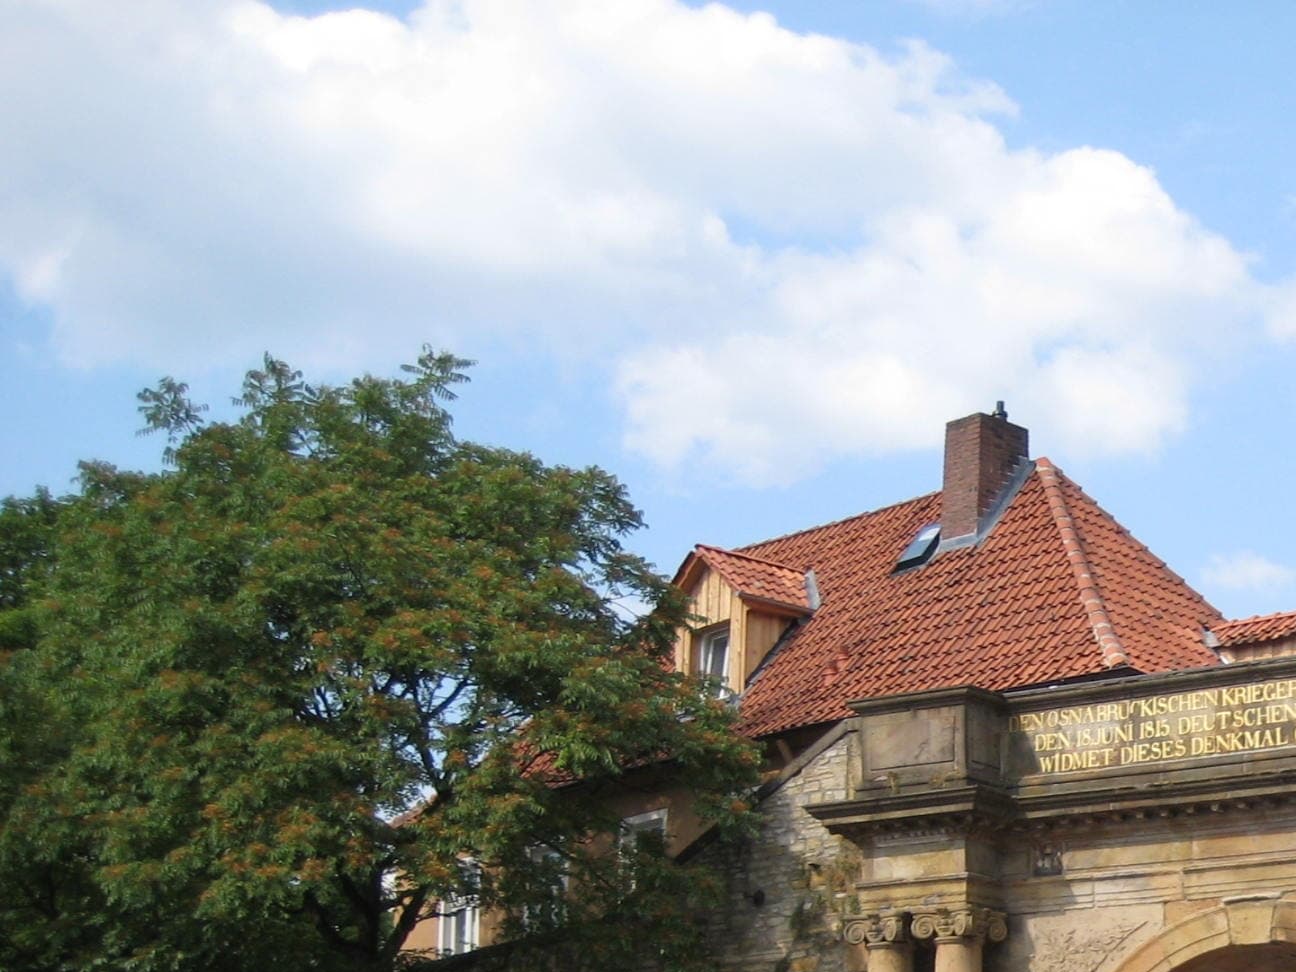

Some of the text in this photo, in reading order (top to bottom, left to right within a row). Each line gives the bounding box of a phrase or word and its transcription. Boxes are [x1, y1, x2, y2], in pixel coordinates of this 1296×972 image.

[1035, 731, 1071, 752] DEN
[1139, 719, 1171, 740] 1815
[1039, 748, 1114, 773] WIDMET
[1120, 738, 1186, 765] DIESES
[1191, 725, 1289, 756] DENKMAL
